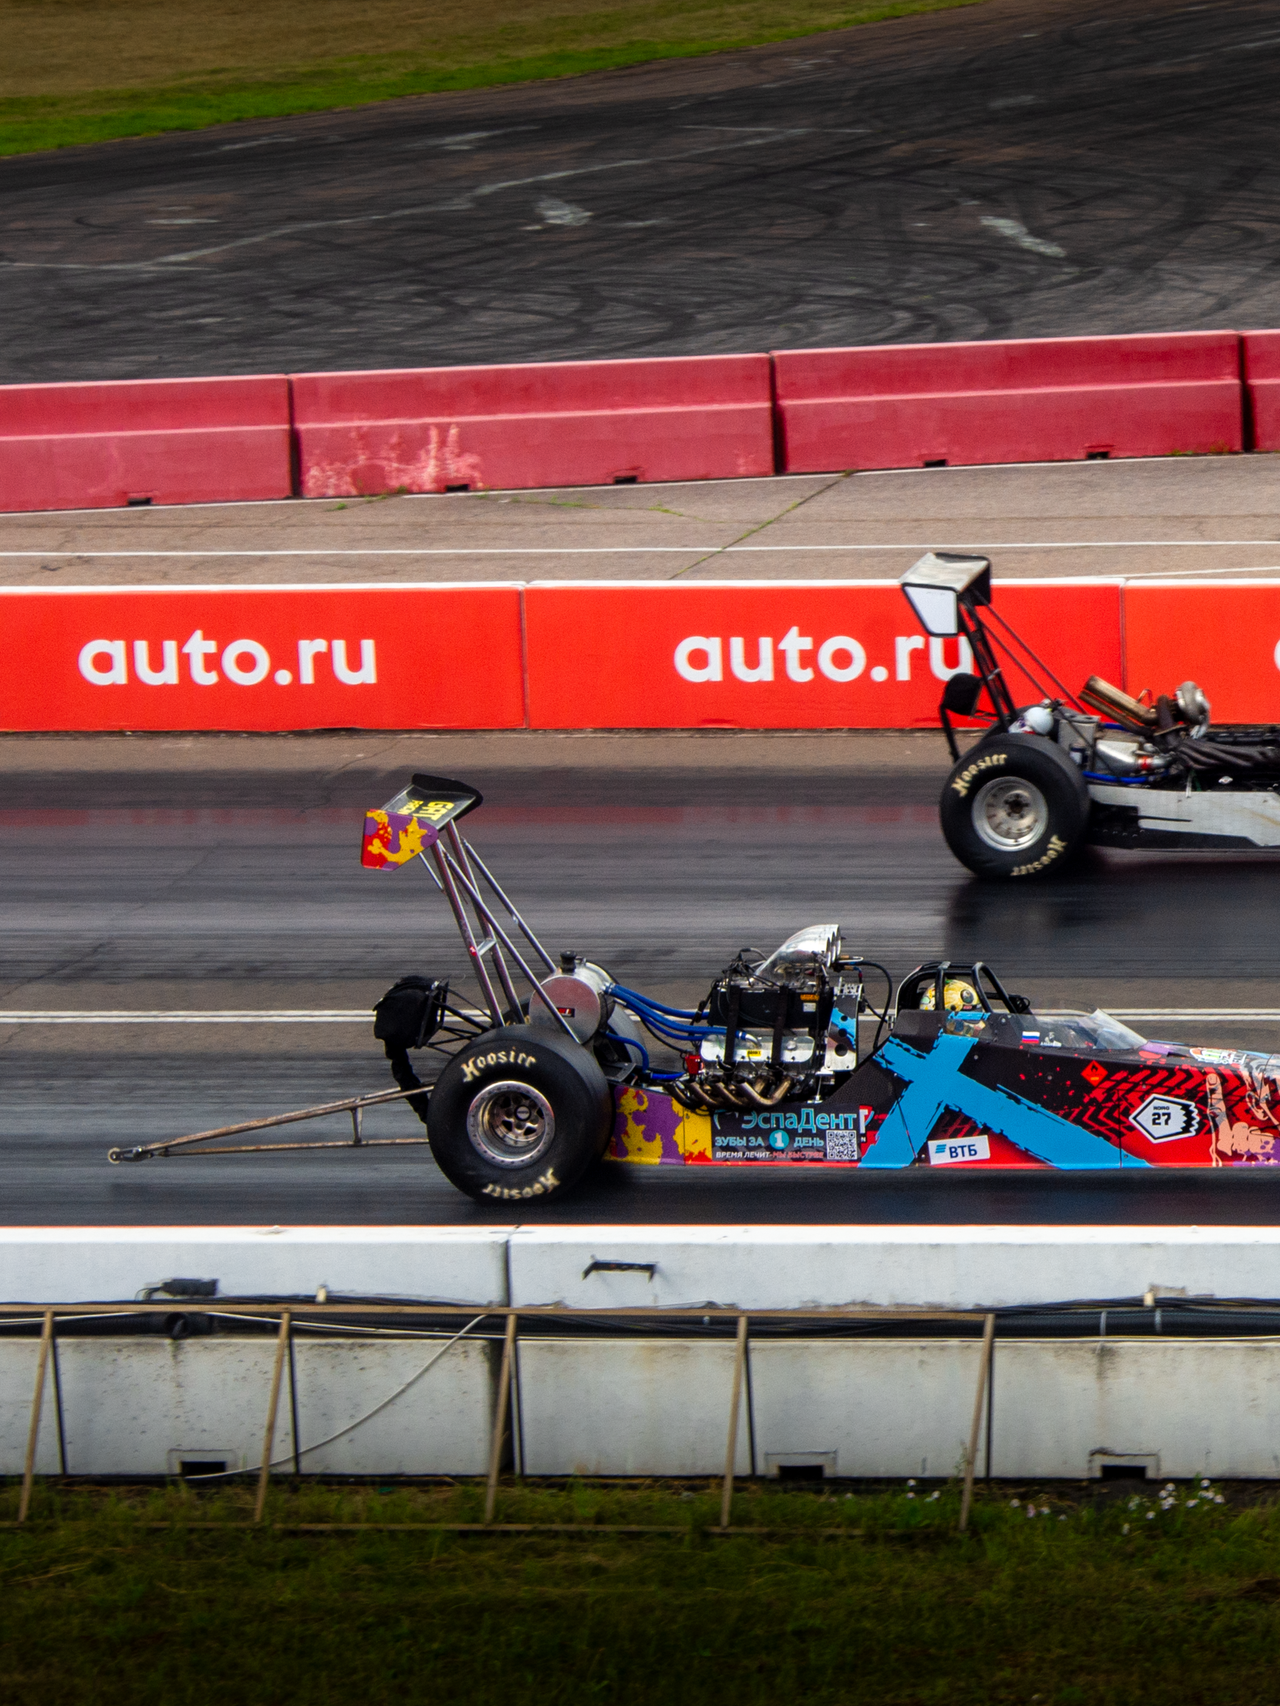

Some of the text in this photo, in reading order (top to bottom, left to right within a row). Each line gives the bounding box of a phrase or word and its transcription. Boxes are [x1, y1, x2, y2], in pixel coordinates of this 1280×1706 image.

[77, 629, 377, 686] auto.ru
[673, 626, 974, 683] auto.ru
[461, 1046, 537, 1083] Hoosier
[741, 1108, 858, 1134] ЭспаДент
[1151, 1112, 1172, 1126] 27
[714, 1132, 825, 1148] ЗУБЫ ЗА 1 ДЕНЬ
[715, 1151, 743, 1159] ВРЕМЯ
[949, 1143, 978, 1159] ВТБ
